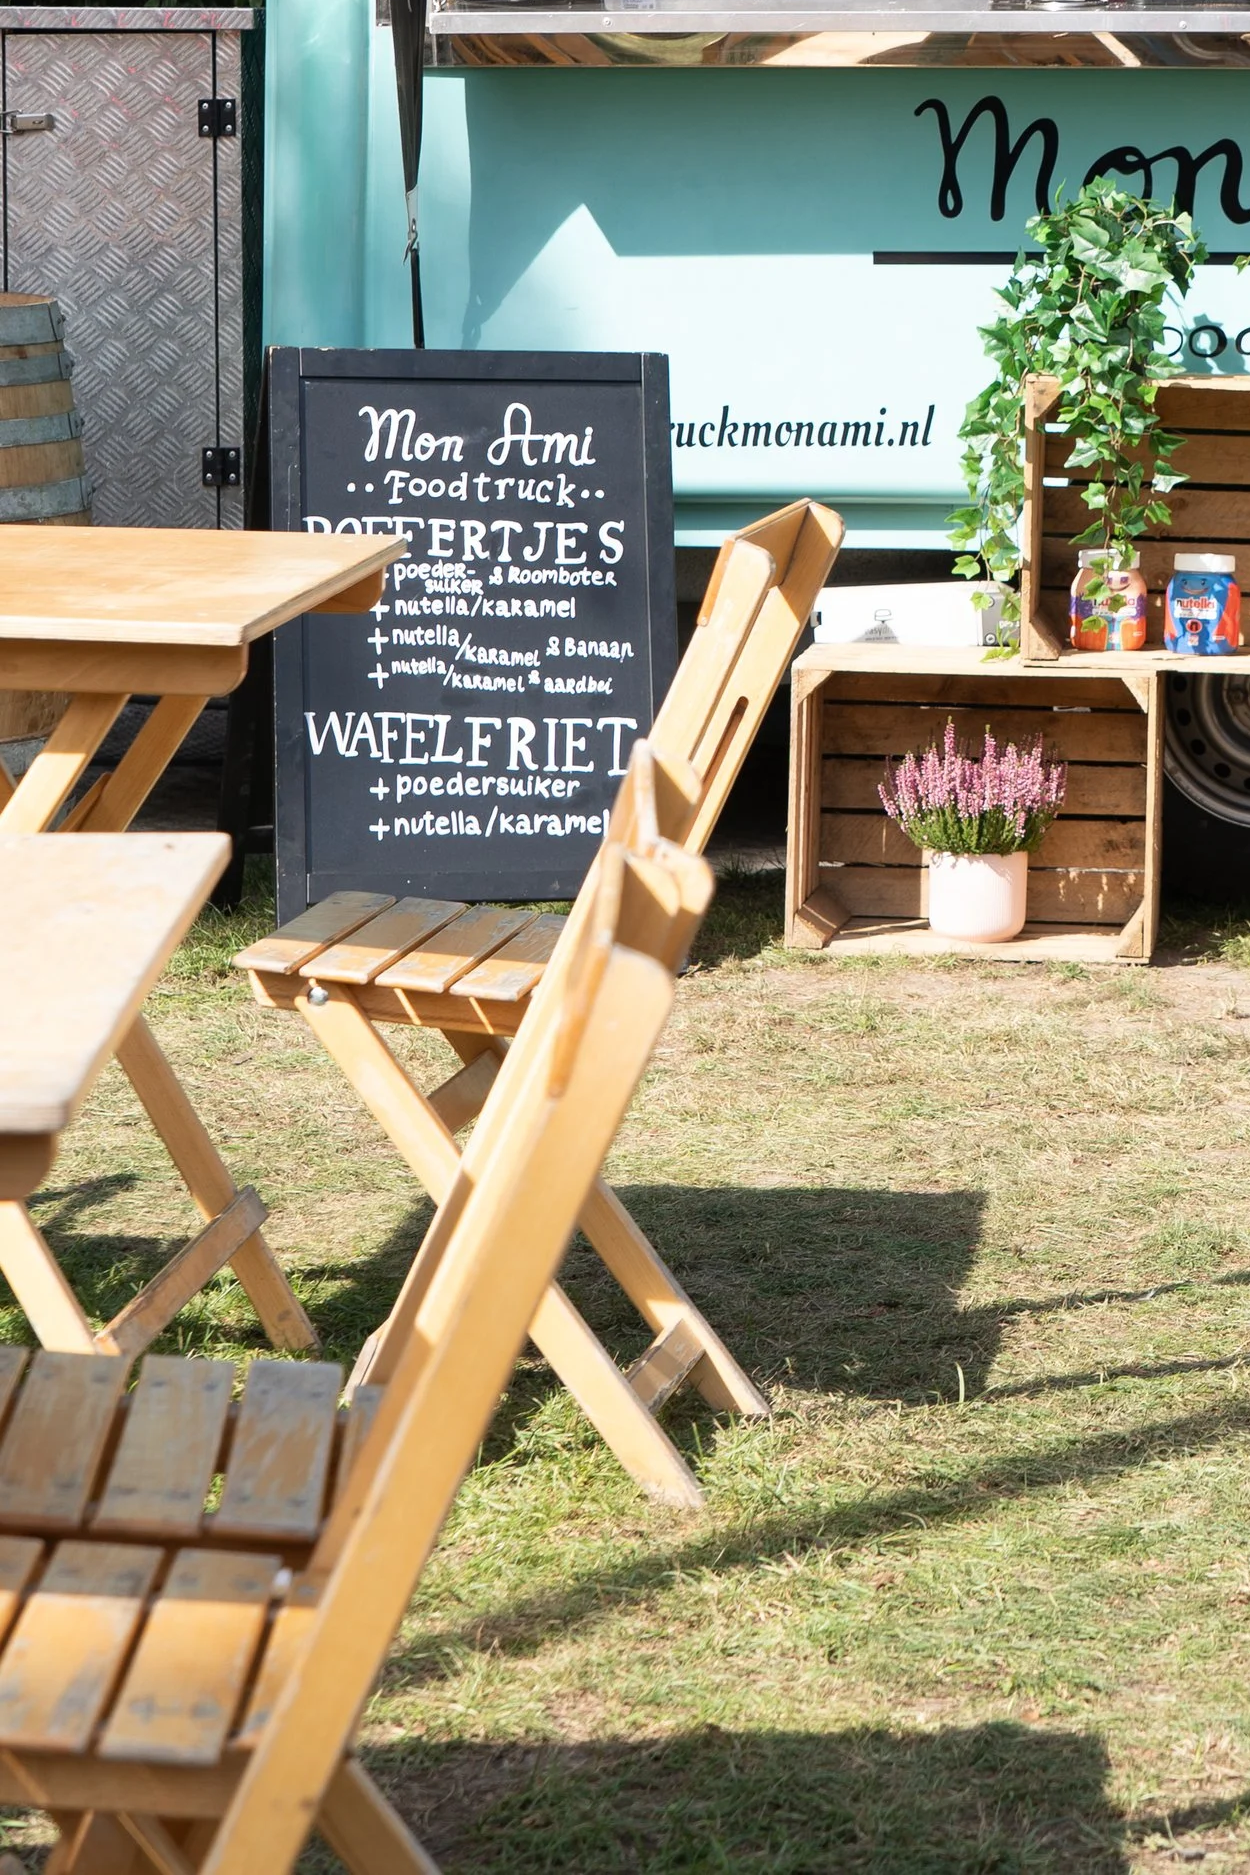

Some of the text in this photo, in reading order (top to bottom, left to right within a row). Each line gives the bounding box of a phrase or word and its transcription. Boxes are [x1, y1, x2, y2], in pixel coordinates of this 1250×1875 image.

[358, 402, 597, 467] Mon Ami
[669, 404, 936, 448] uckmonami.nl
[1177, 597, 1215, 610] nutella
